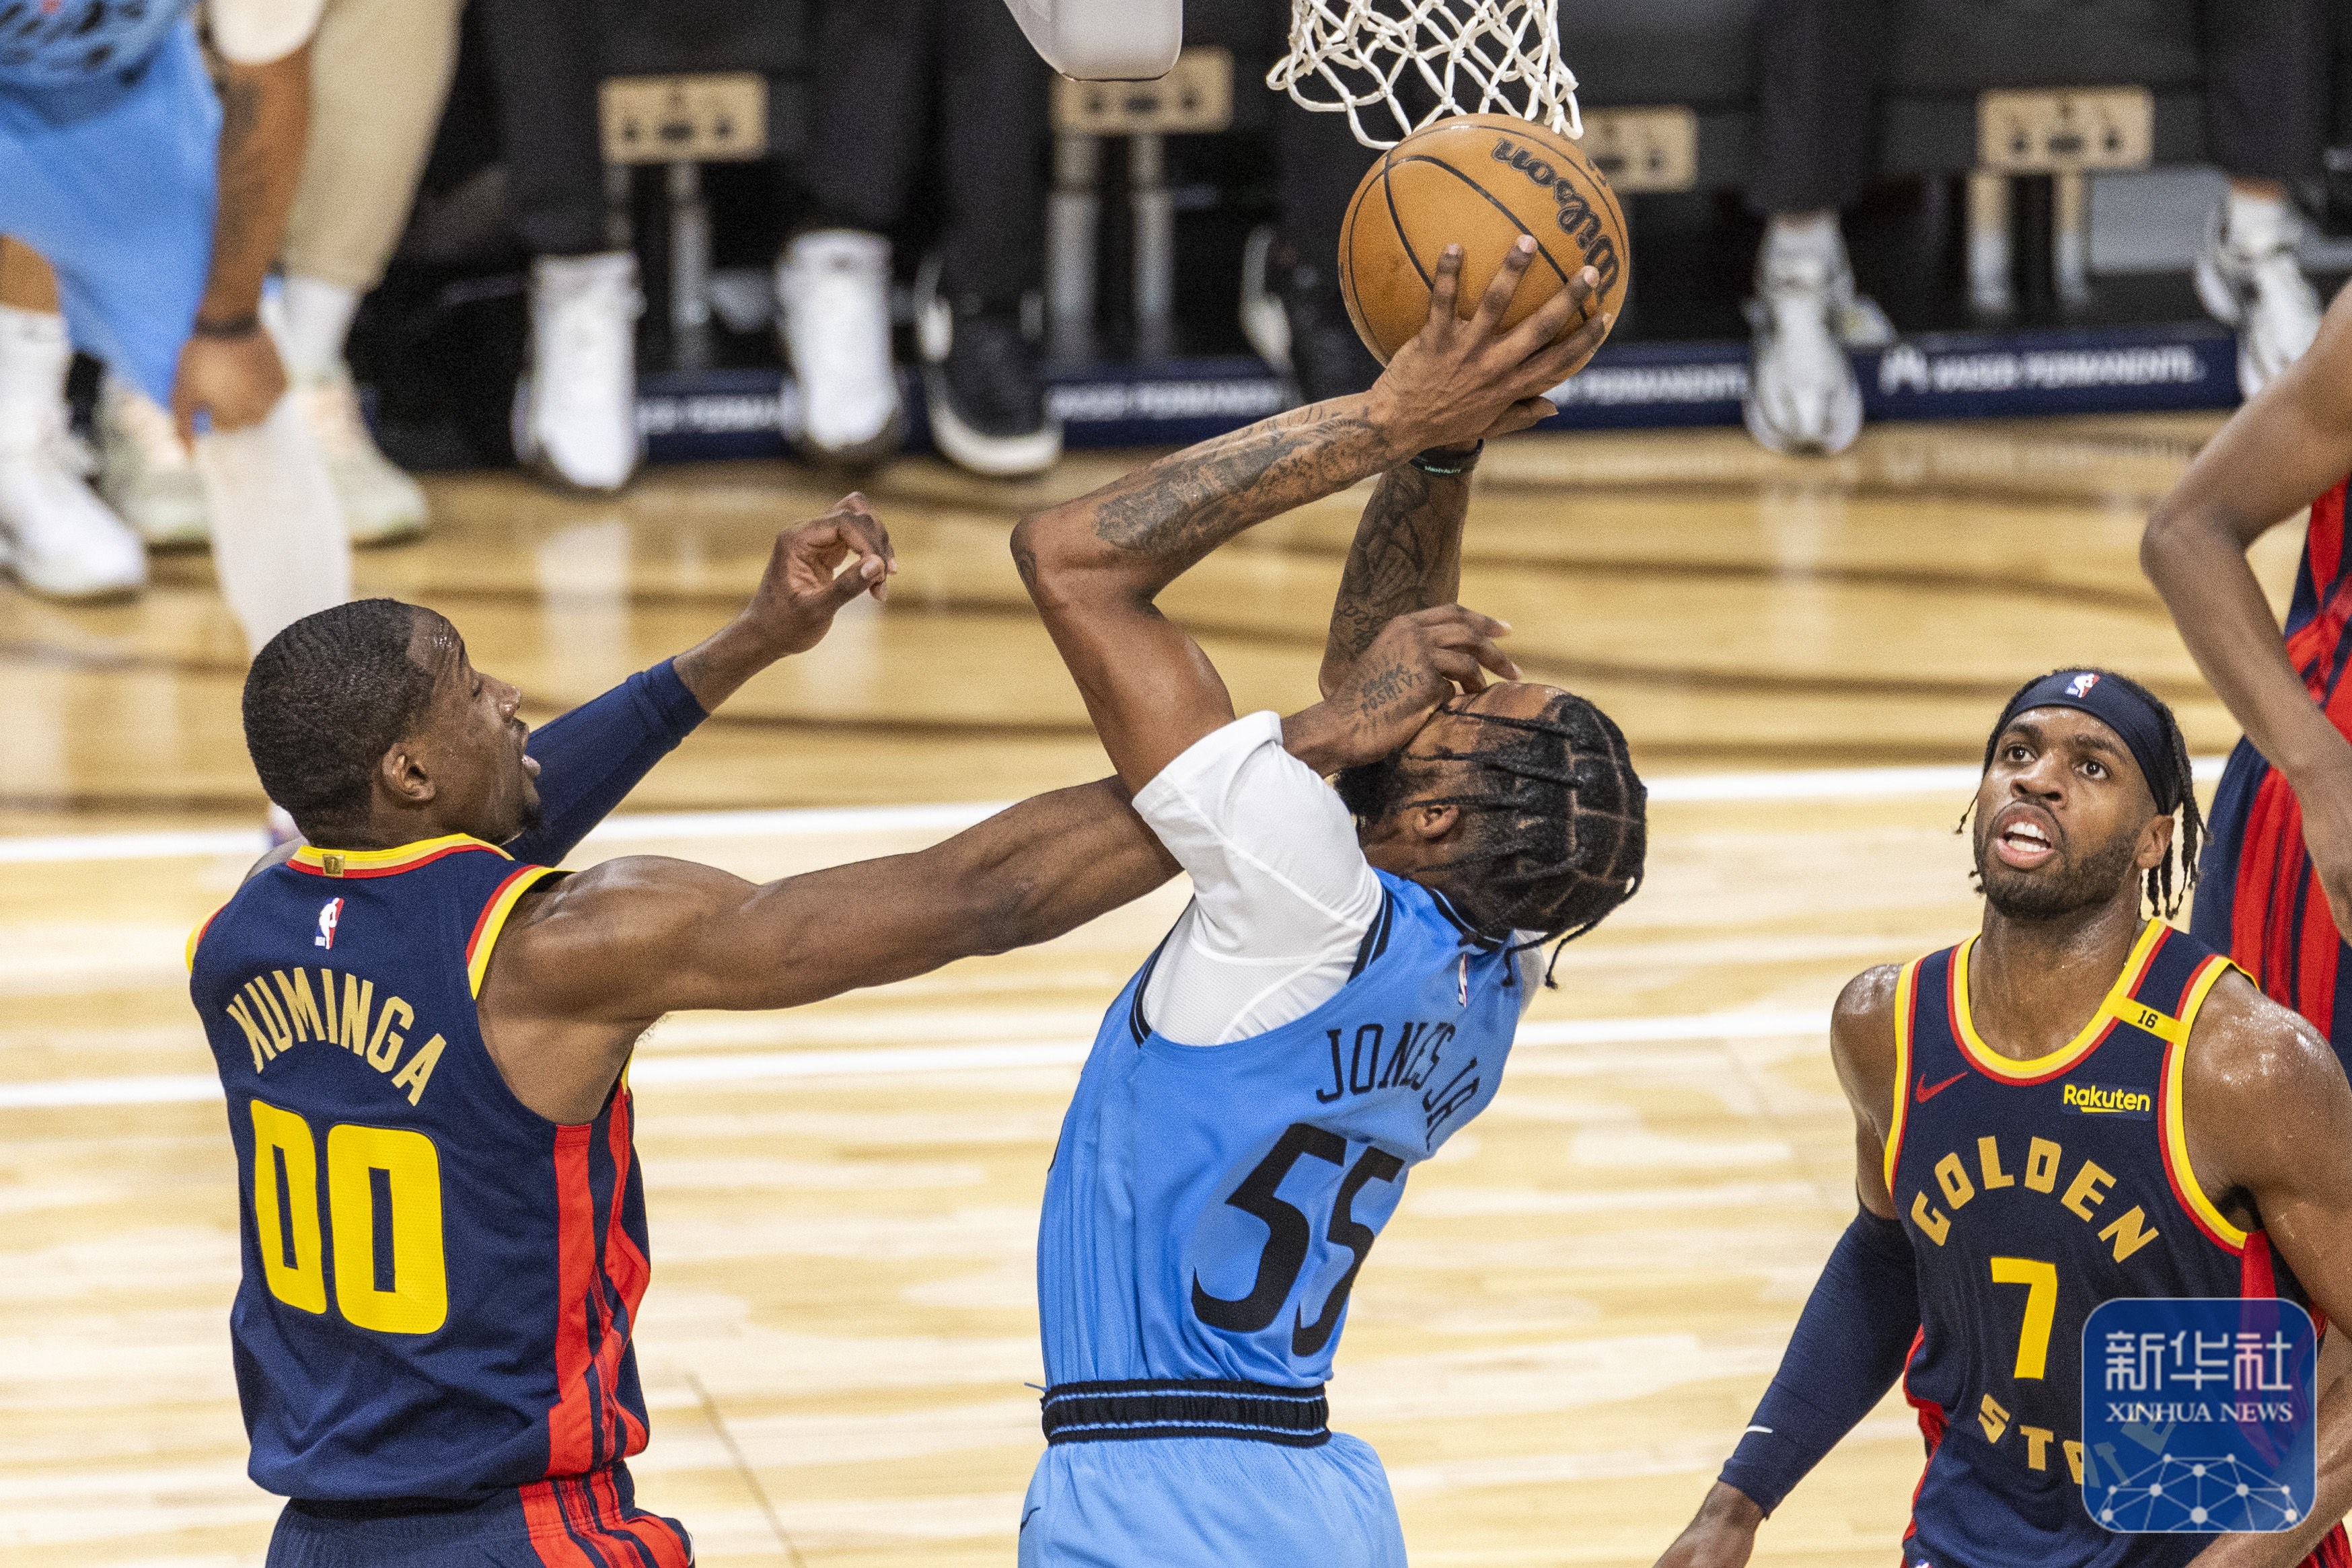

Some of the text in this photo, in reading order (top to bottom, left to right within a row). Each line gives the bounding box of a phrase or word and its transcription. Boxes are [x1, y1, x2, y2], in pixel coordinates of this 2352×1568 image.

[1491, 137, 1619, 305] Wilson
[226, 967, 447, 1107] KUMINGA
[2137, 1009, 2159, 1029] 16
[1316, 1021, 1480, 1152] JONES JR
[2063, 1084, 2151, 1113] Rakuten
[250, 1098, 449, 1335] 00
[1191, 1122, 1405, 1357] 55
[1909, 1135, 2160, 1265] GOLDEN
[1989, 1256, 2059, 1380] 7
